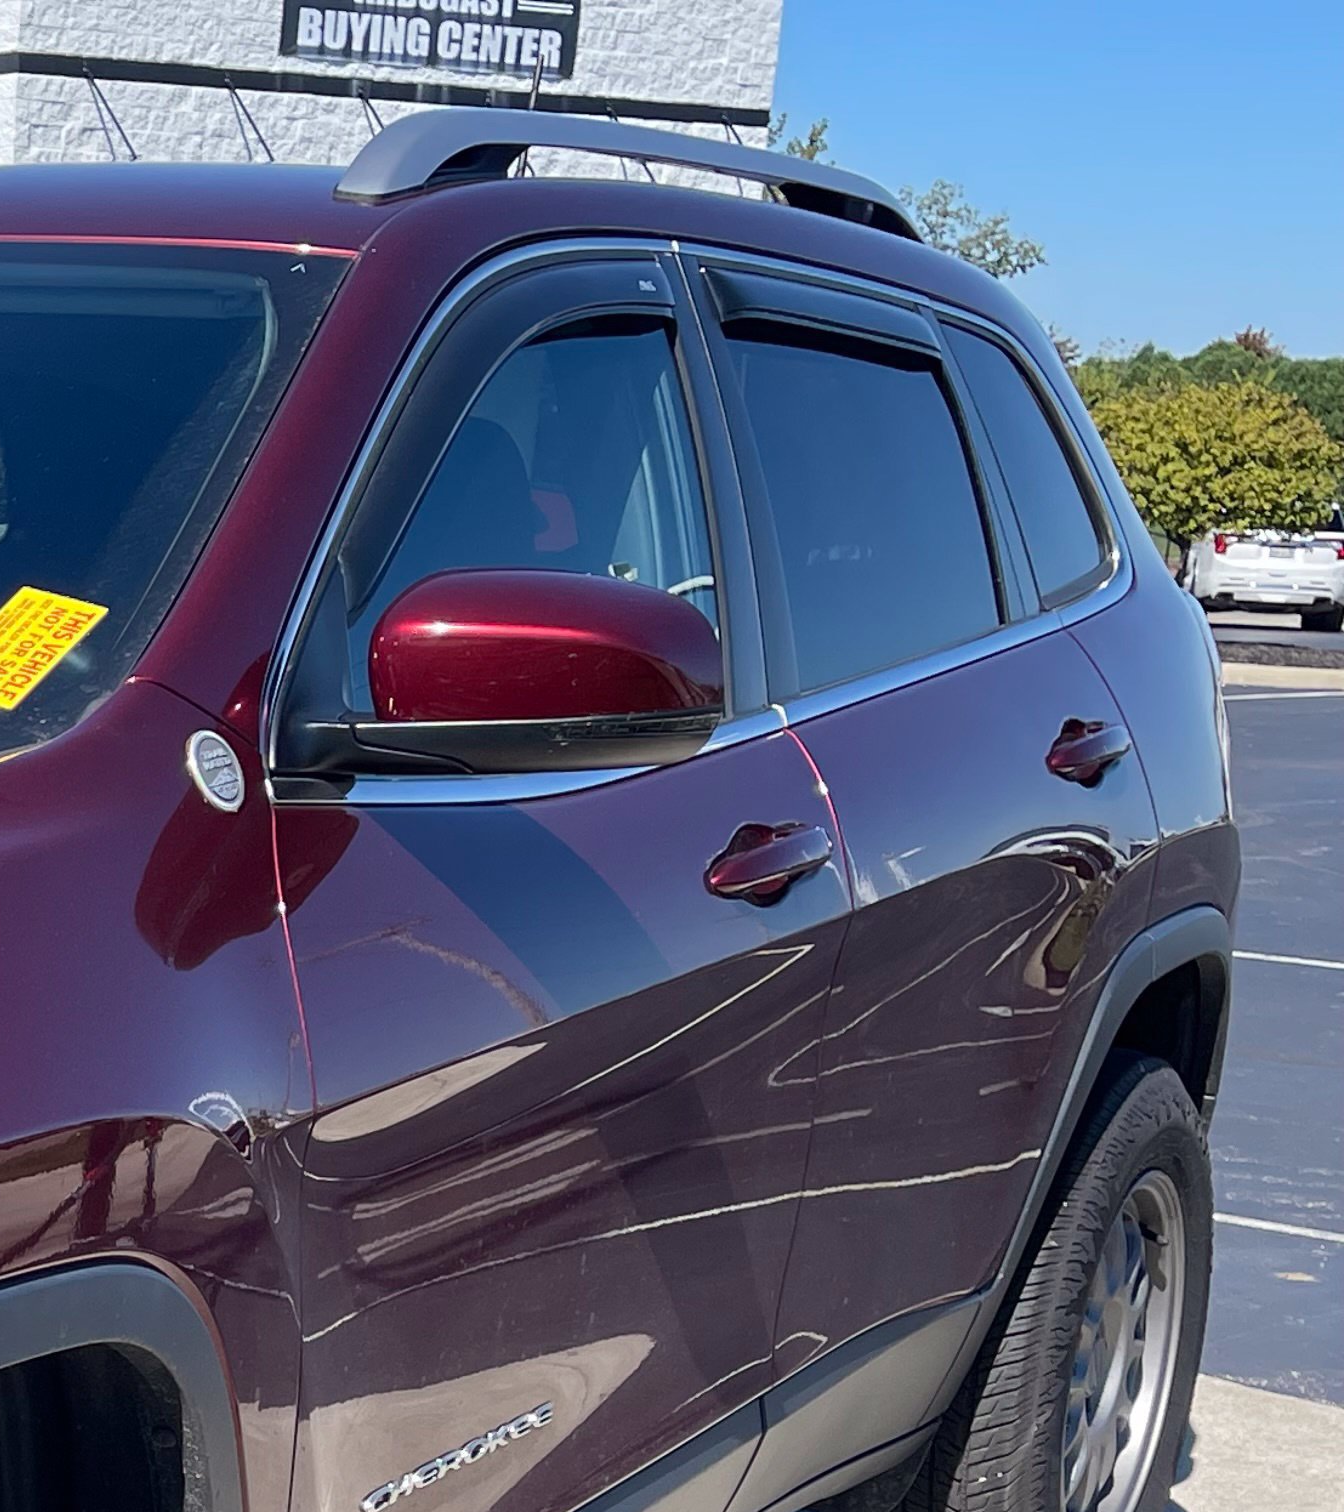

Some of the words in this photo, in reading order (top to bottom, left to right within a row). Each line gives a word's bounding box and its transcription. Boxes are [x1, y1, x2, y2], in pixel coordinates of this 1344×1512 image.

[296, 6, 432, 58] BUYING
[436, 19, 563, 69] CENTER
[36, 608, 68, 631] NOT
[50, 611, 96, 642] THIS
[9, 632, 44, 658] FOR
